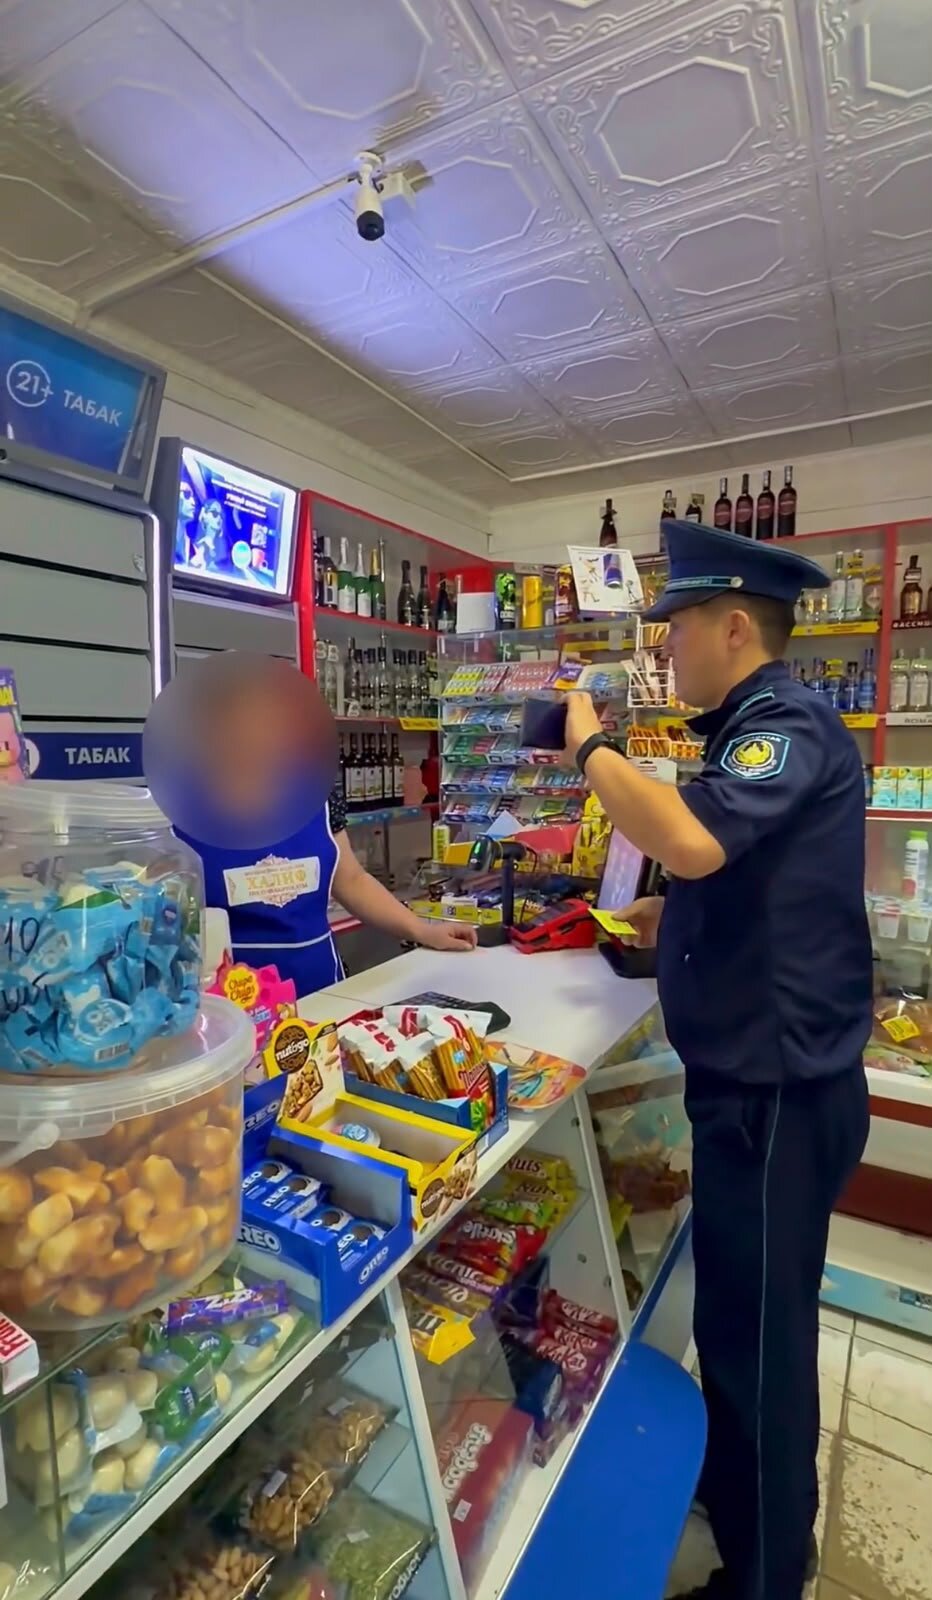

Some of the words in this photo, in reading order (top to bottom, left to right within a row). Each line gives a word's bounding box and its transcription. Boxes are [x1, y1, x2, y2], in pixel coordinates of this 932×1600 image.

[15, 371, 54, 396] 21+
[63, 389, 122, 427] ТАБАК
[64, 747, 130, 764] ТАБАК
[243, 1102, 278, 1130] REO
[241, 1170, 263, 1193] REO
[262, 1184, 290, 1207] REO
[240, 1226, 279, 1251] REO
[359, 1246, 389, 1284] OREO
